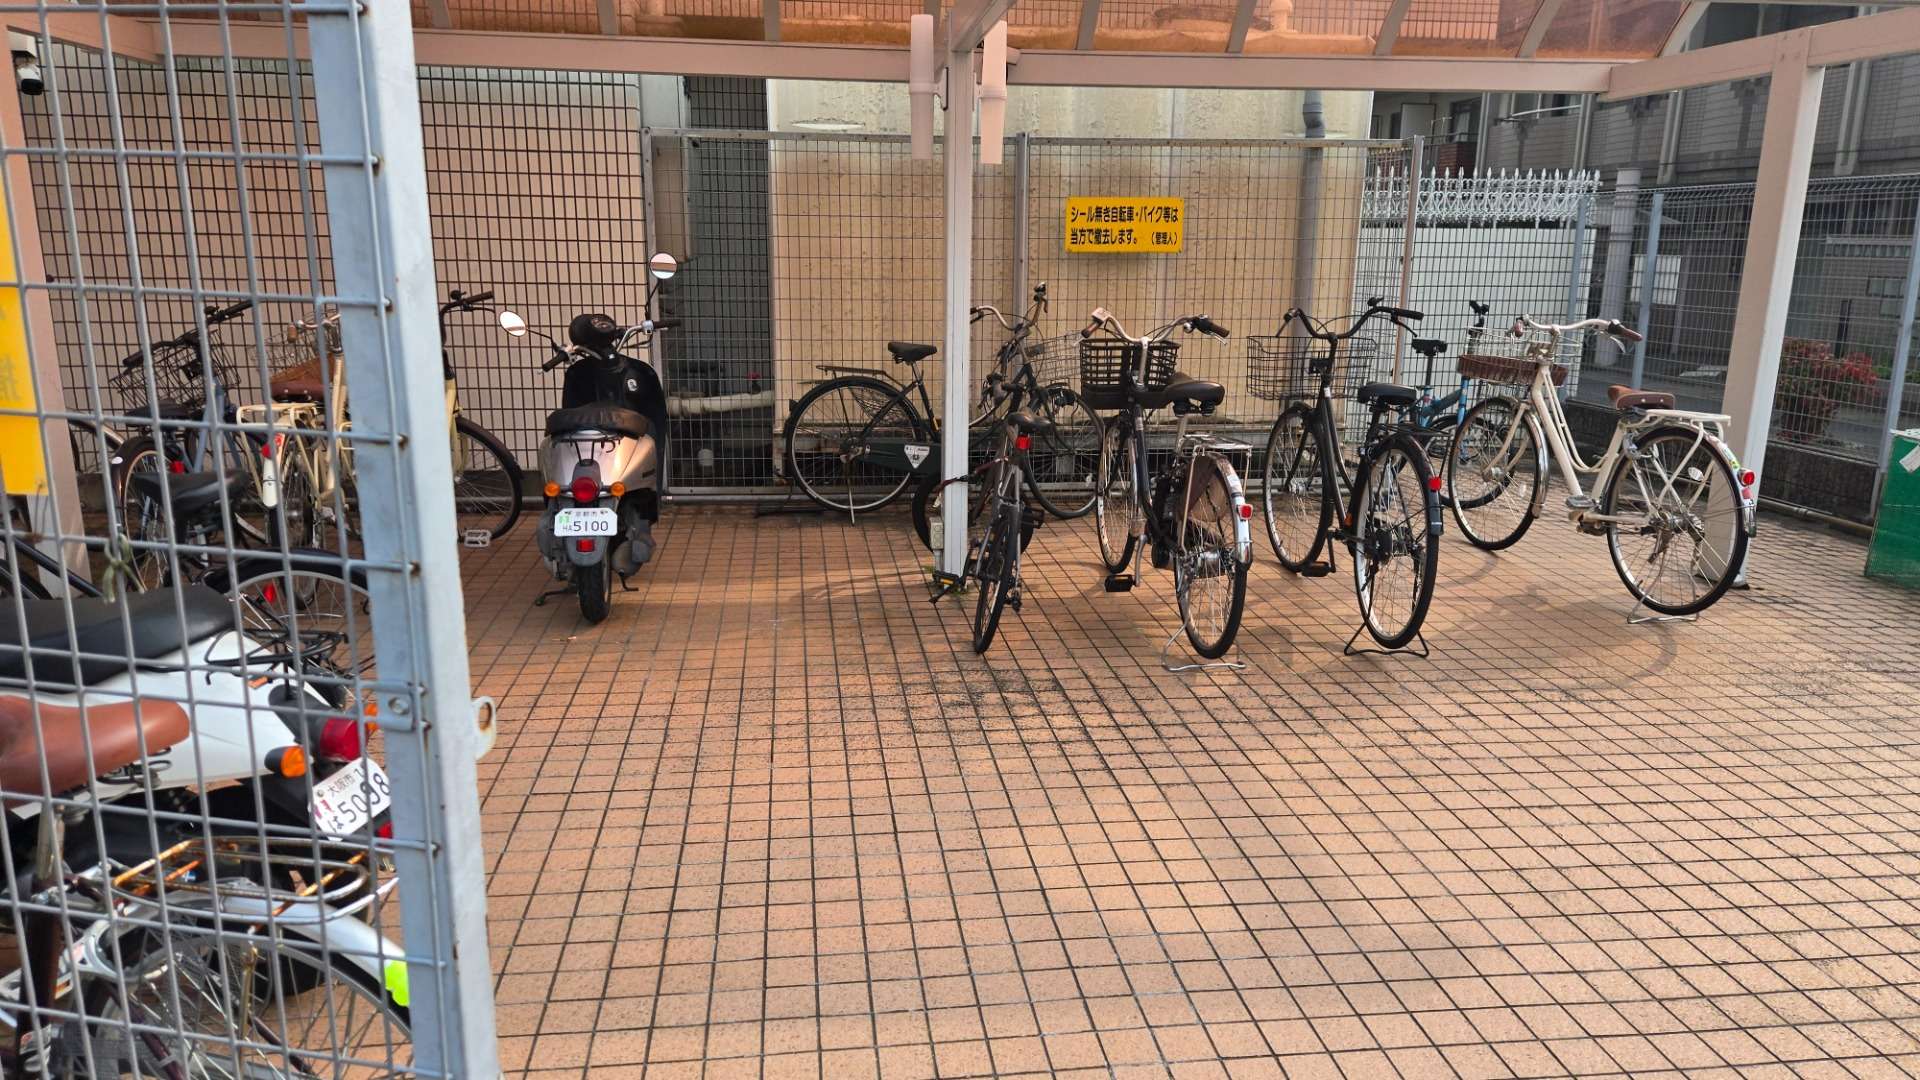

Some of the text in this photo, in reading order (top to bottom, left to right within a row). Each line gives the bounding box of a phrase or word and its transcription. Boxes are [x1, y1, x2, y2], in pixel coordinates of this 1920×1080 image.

[1071, 206, 1179, 223] シール無き自転車・バイク等は
[1070, 228, 1138, 245] 当方で撤去します。
[573, 520, 609, 532] 5100
[337, 772, 392, 824] 5098
